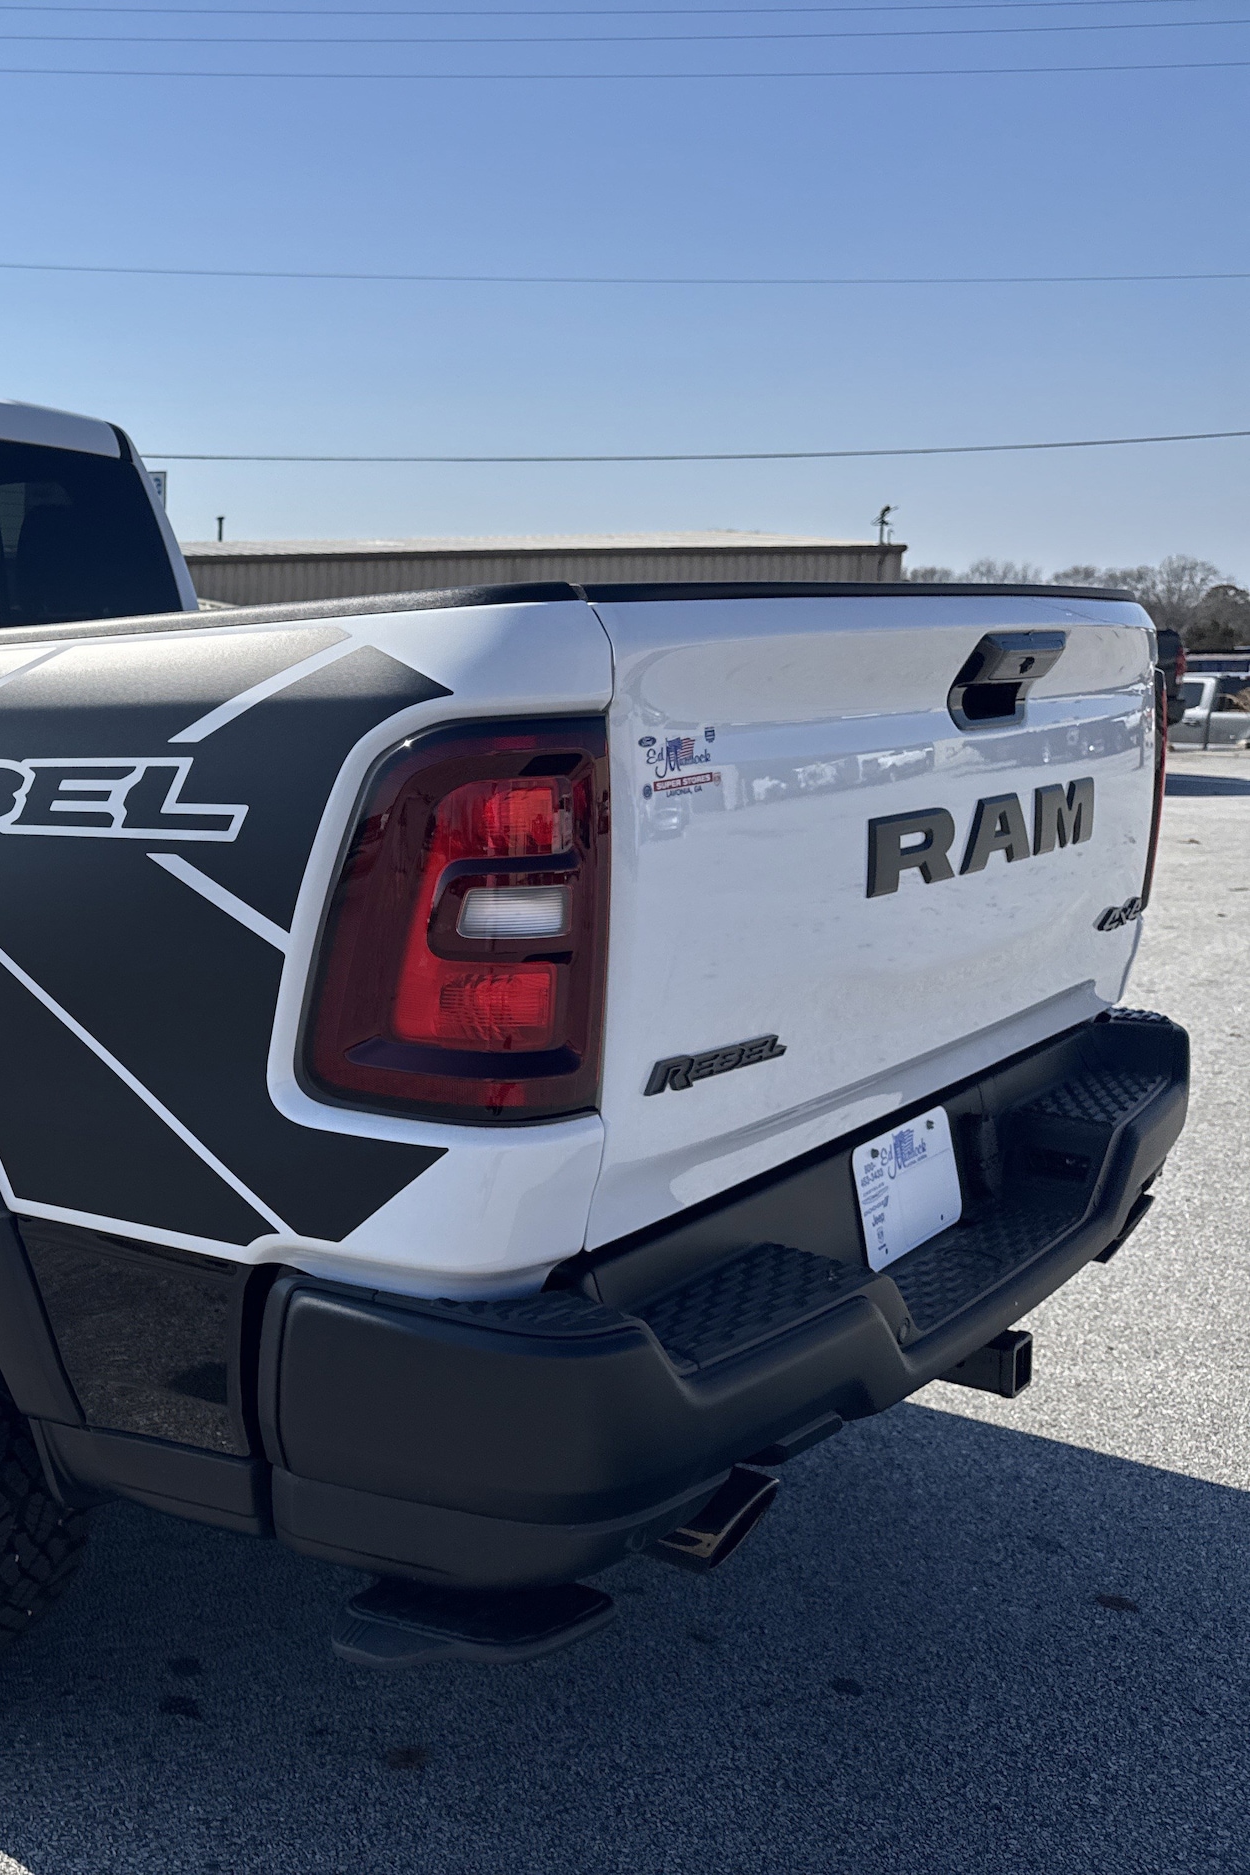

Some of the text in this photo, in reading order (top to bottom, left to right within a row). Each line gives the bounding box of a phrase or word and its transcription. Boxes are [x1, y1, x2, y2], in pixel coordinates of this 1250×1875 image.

[646, 747, 664, 765] Ed
[655, 779, 682, 791] SUPER
[682, 774, 711, 786] STORES
[866, 776, 1095, 899] RAM
[643, 1034, 788, 1097] REBEL
